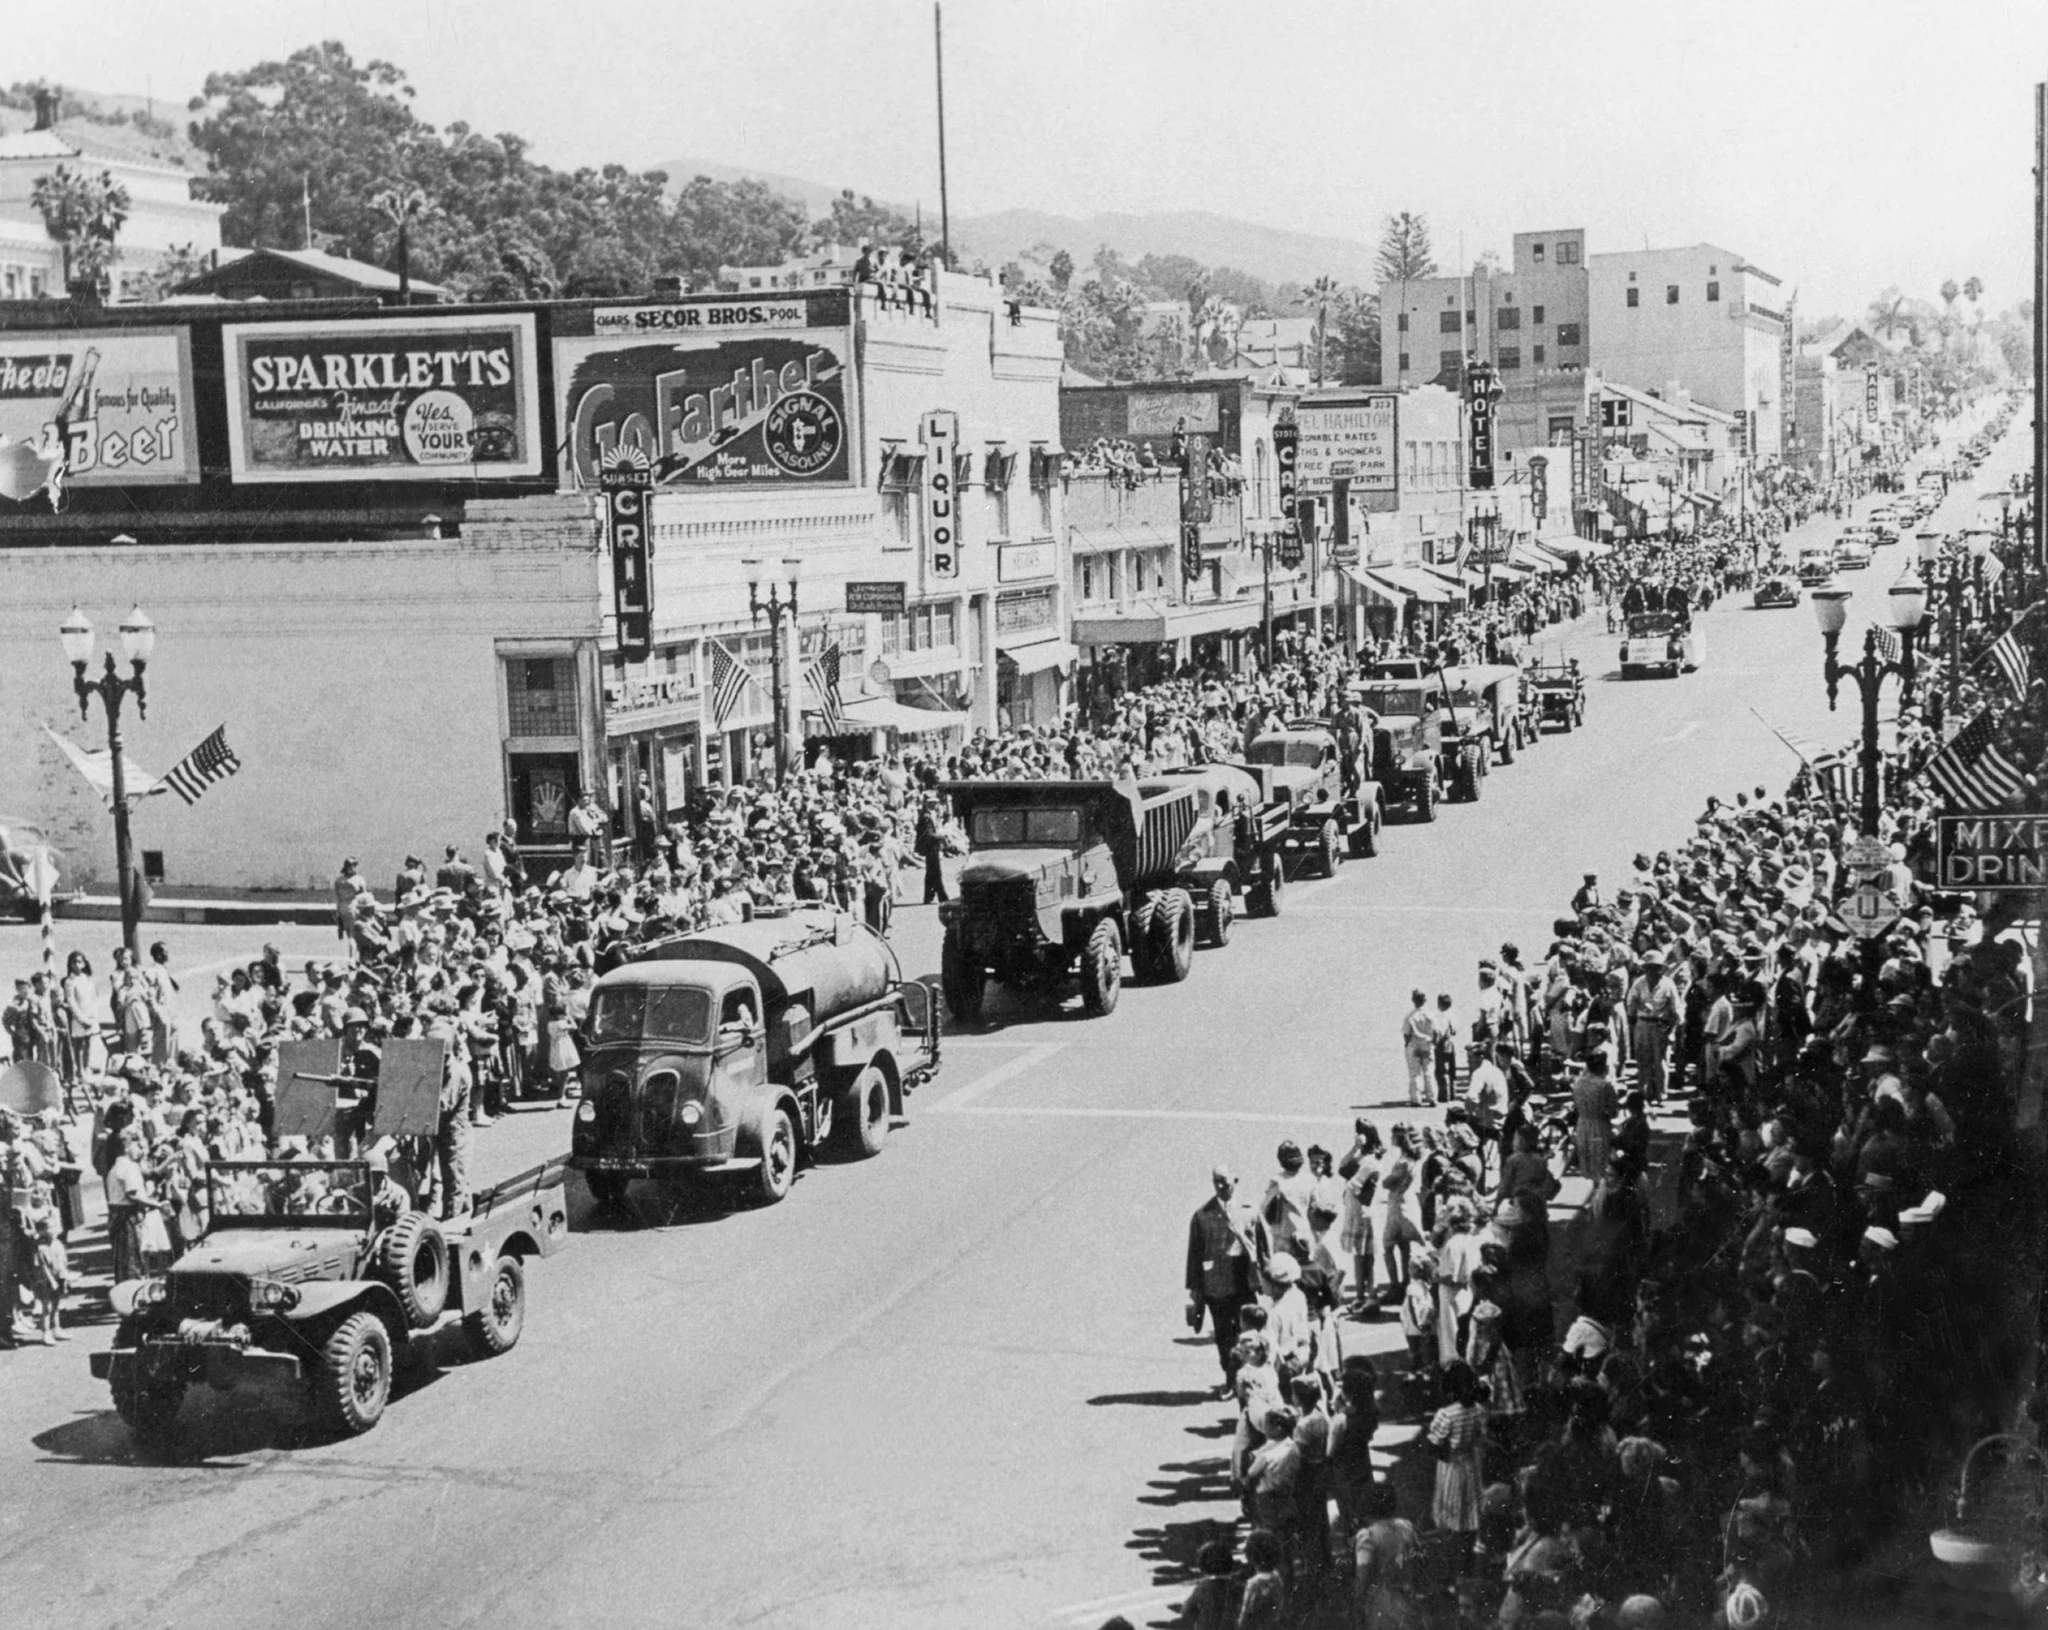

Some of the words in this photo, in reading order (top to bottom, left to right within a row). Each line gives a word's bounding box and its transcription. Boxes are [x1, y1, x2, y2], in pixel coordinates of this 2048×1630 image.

[635, 309, 701, 328] SECOR
[708, 307, 767, 325] BROS.
[770, 308, 802, 320] POOL
[0, 356, 67, 392] heela
[141, 387, 176, 414] Quality
[334, 390, 405, 421] Finest
[656, 350, 824, 457] Farther
[1868, 366, 1877, 421] WARDS
[300, 419, 400, 439] DRINKING
[416, 402, 454, 431] Yes
[769, 397, 834, 434] SIGNAL
[1299, 412, 1319, 429] TEL
[1324, 411, 1392, 429] HAMILTON
[1473, 379, 1487, 469] HOTEL
[67, 415, 178, 475] Beer
[310, 438, 390, 457] WATER
[418, 433, 464, 449] YOUR
[1297, 447, 1318, 456] THS
[1337, 446, 1382, 456] SHOWERS
[1300, 433, 1340, 442] ONABLE
[1345, 432, 1377, 441] RATES
[717, 453, 747, 465] More
[772, 441, 833, 469] GASOLINE
[602, 472, 649, 484] SUNSET
[697, 466, 725, 481] High
[727, 466, 748, 477] Gear
[752, 465, 780, 477] Miles
[929, 420, 952, 573] LIQUOR
[1280, 446, 1297, 535] CAFE
[1956, 820, 2048, 850] MIXE
[1947, 855, 2048, 884] DRIN
[1857, 895, 1879, 920] U
